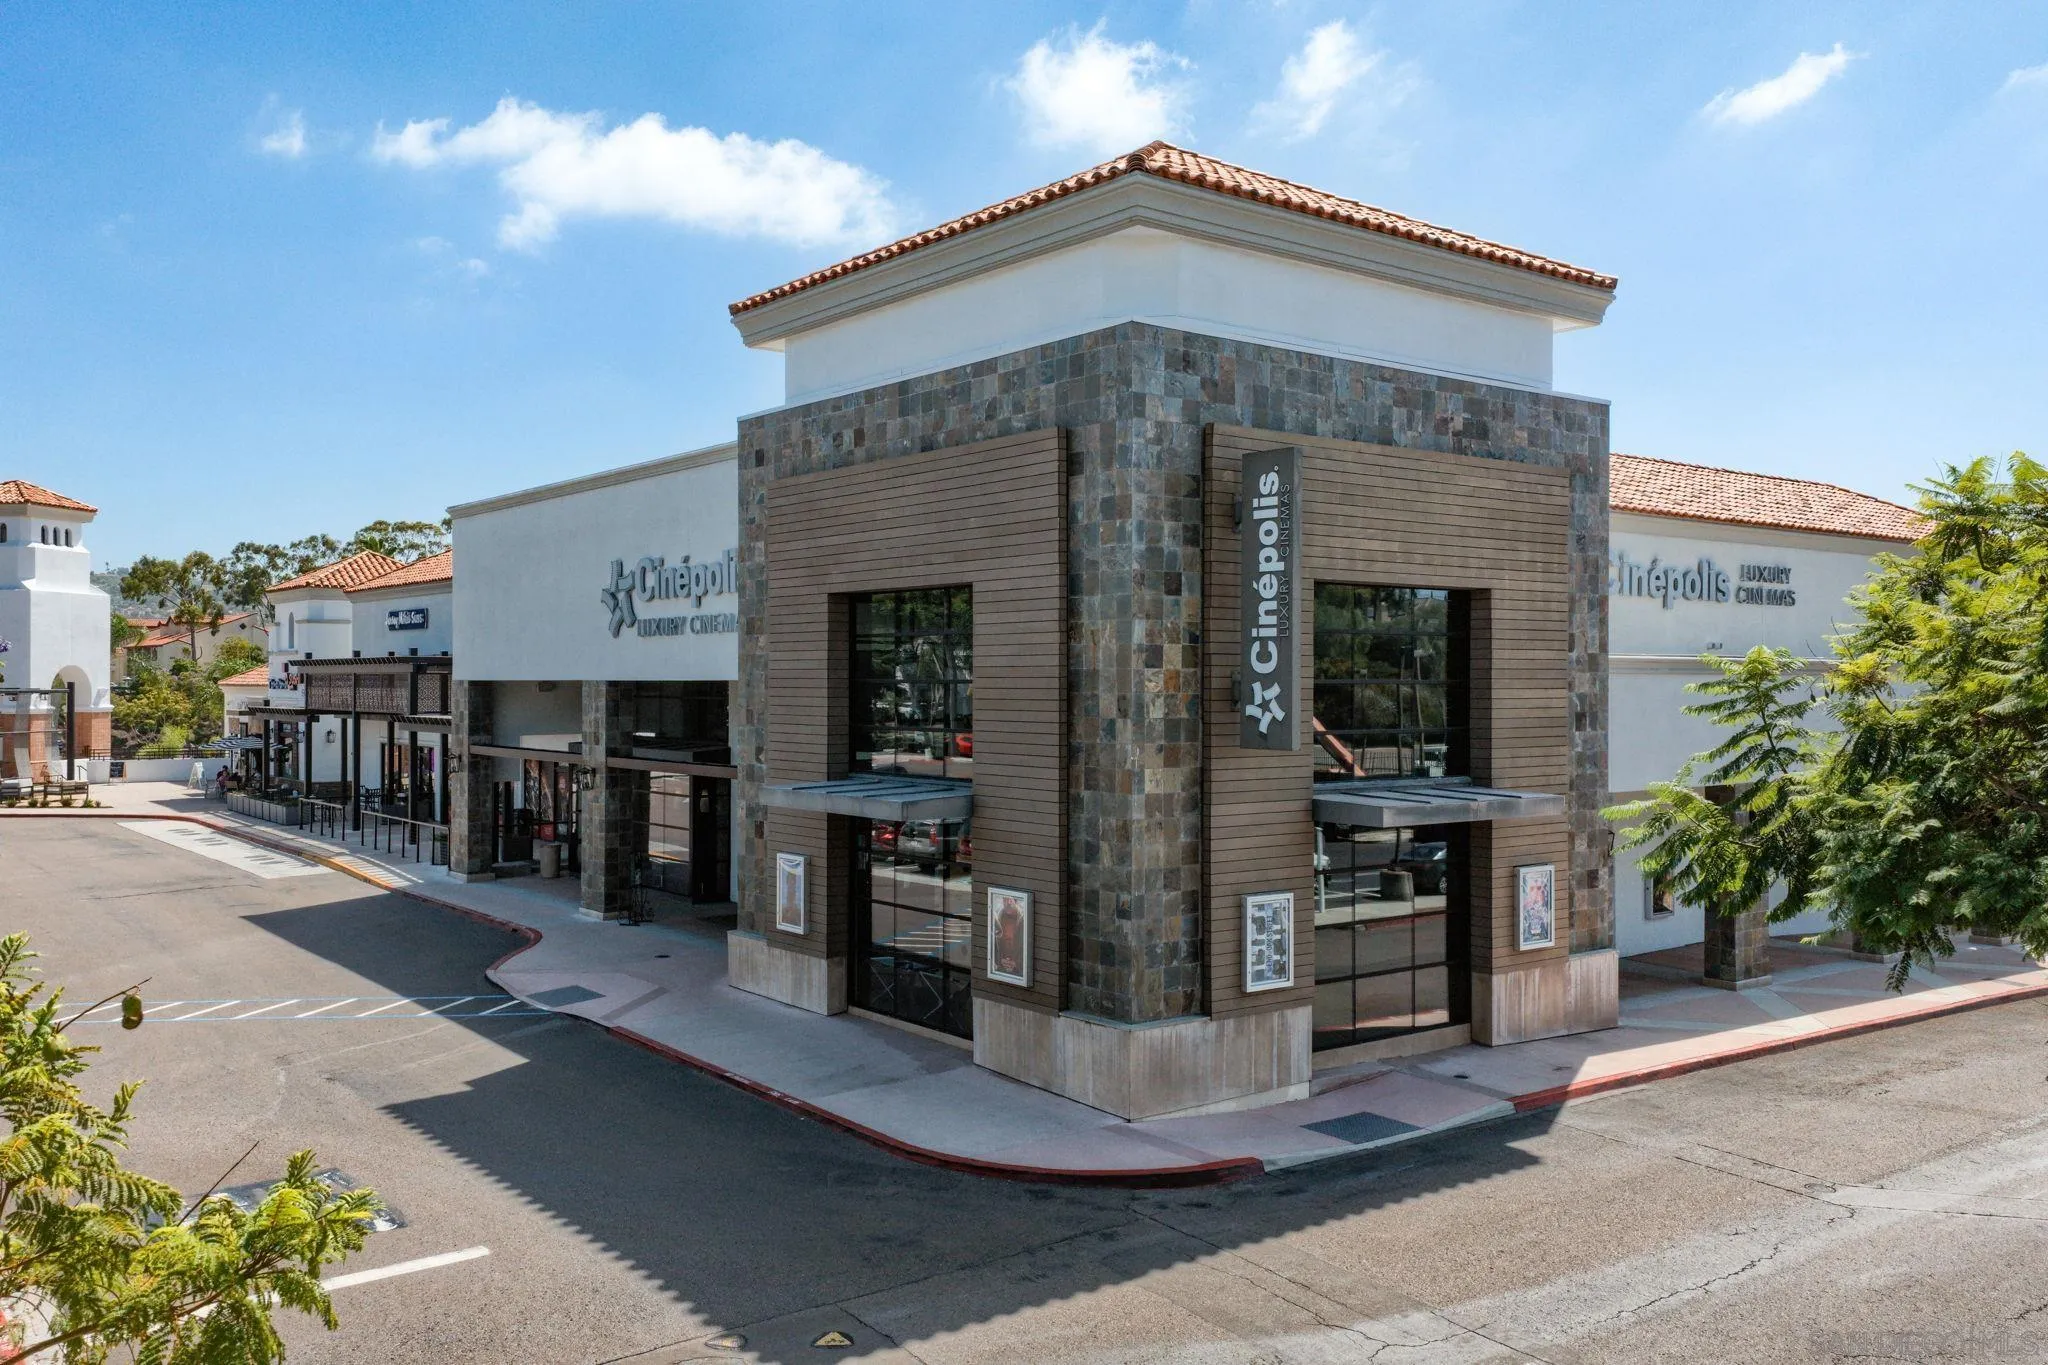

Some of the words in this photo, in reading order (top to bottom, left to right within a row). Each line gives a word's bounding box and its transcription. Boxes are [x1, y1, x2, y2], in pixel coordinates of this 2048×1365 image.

[1280, 484, 1290, 556] CINEMAS
[635, 548, 738, 609] Cinépoli
[1250, 472, 1285, 674] Cinépolis
[1736, 586, 1796, 607] CINEMAS
[1739, 564, 1792, 584] LUXURY
[637, 616, 688, 638] LUXURY
[689, 613, 738, 635] CINEM
[1280, 575, 1289, 637] LUXURY
